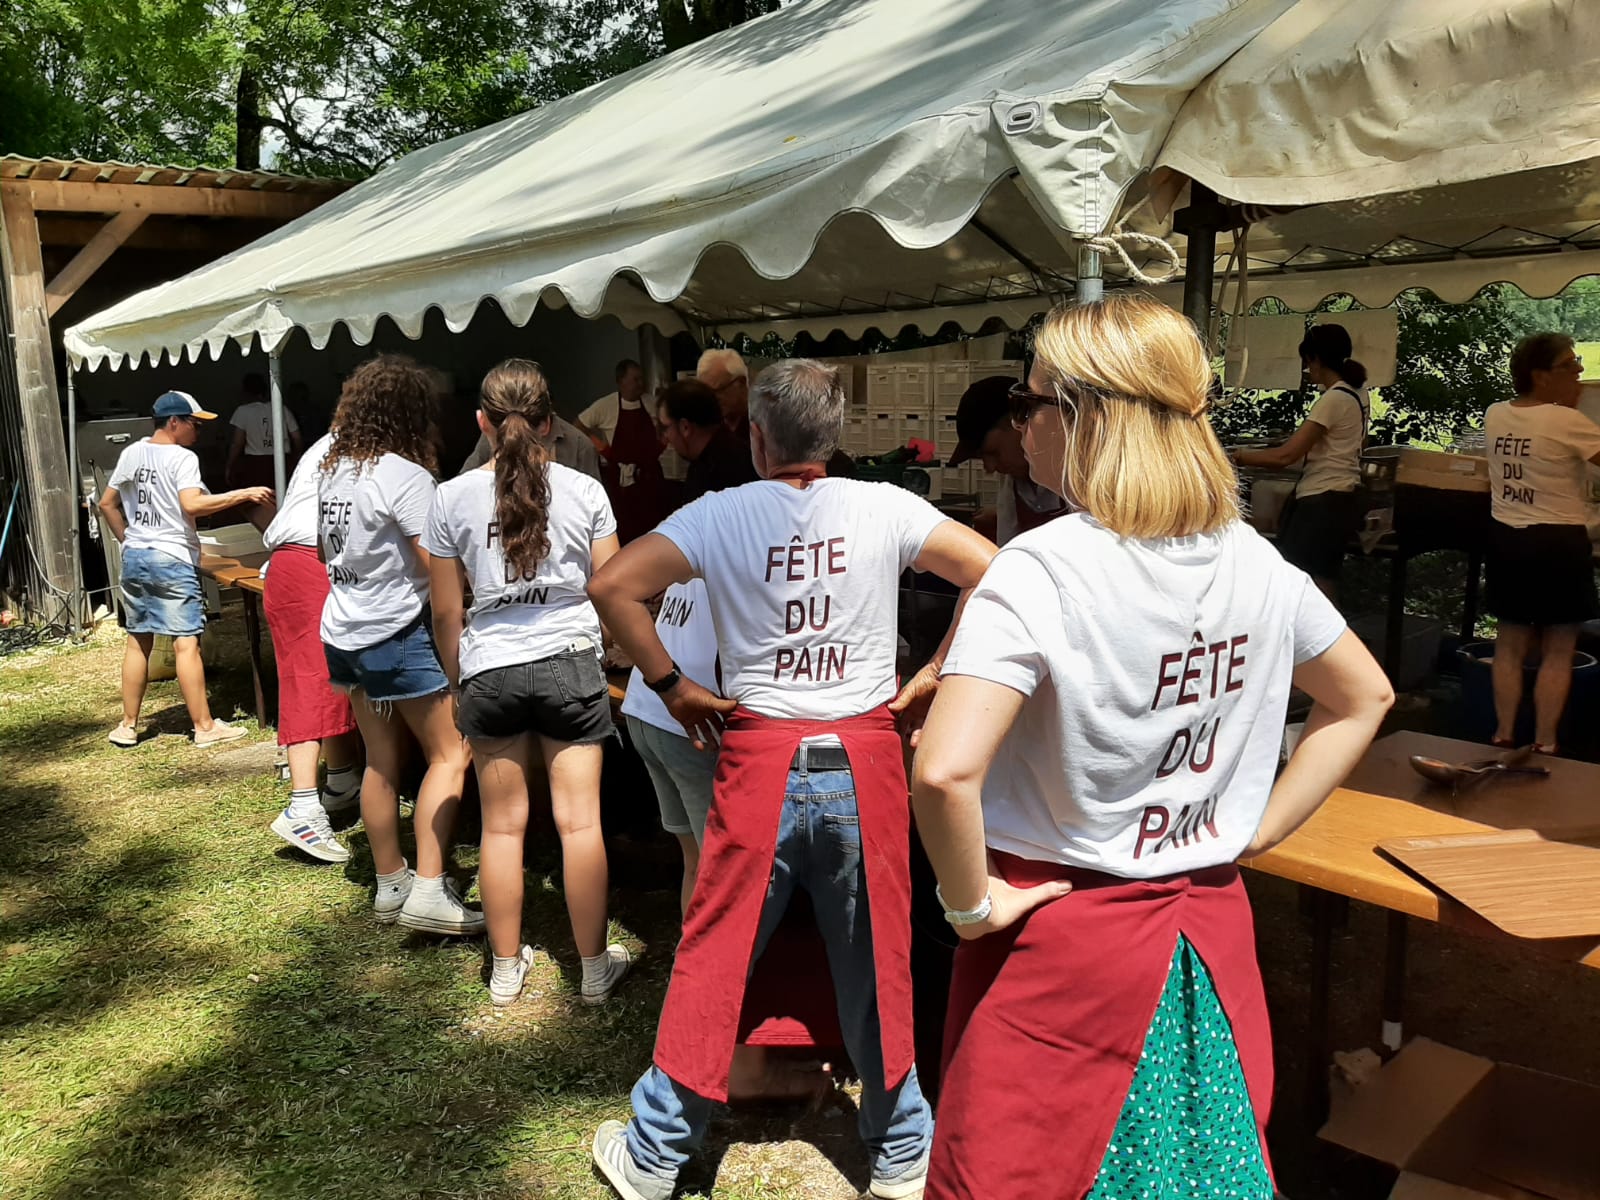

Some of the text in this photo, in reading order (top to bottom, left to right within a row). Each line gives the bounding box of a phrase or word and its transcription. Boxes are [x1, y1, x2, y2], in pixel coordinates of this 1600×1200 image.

[1494, 433, 1532, 457] FÊTE
[1503, 462, 1522, 480] DU
[321, 496, 353, 525] FÊTE
[1502, 485, 1535, 504] PAIN
[133, 511, 161, 527] PAIN
[765, 535, 847, 583] FÊTE
[785, 595, 830, 635] DU
[773, 644, 848, 682] PAIN
[1150, 631, 1249, 711] FÊTE
[1155, 716, 1221, 779] DU
[1133, 792, 1220, 860] PAIN
